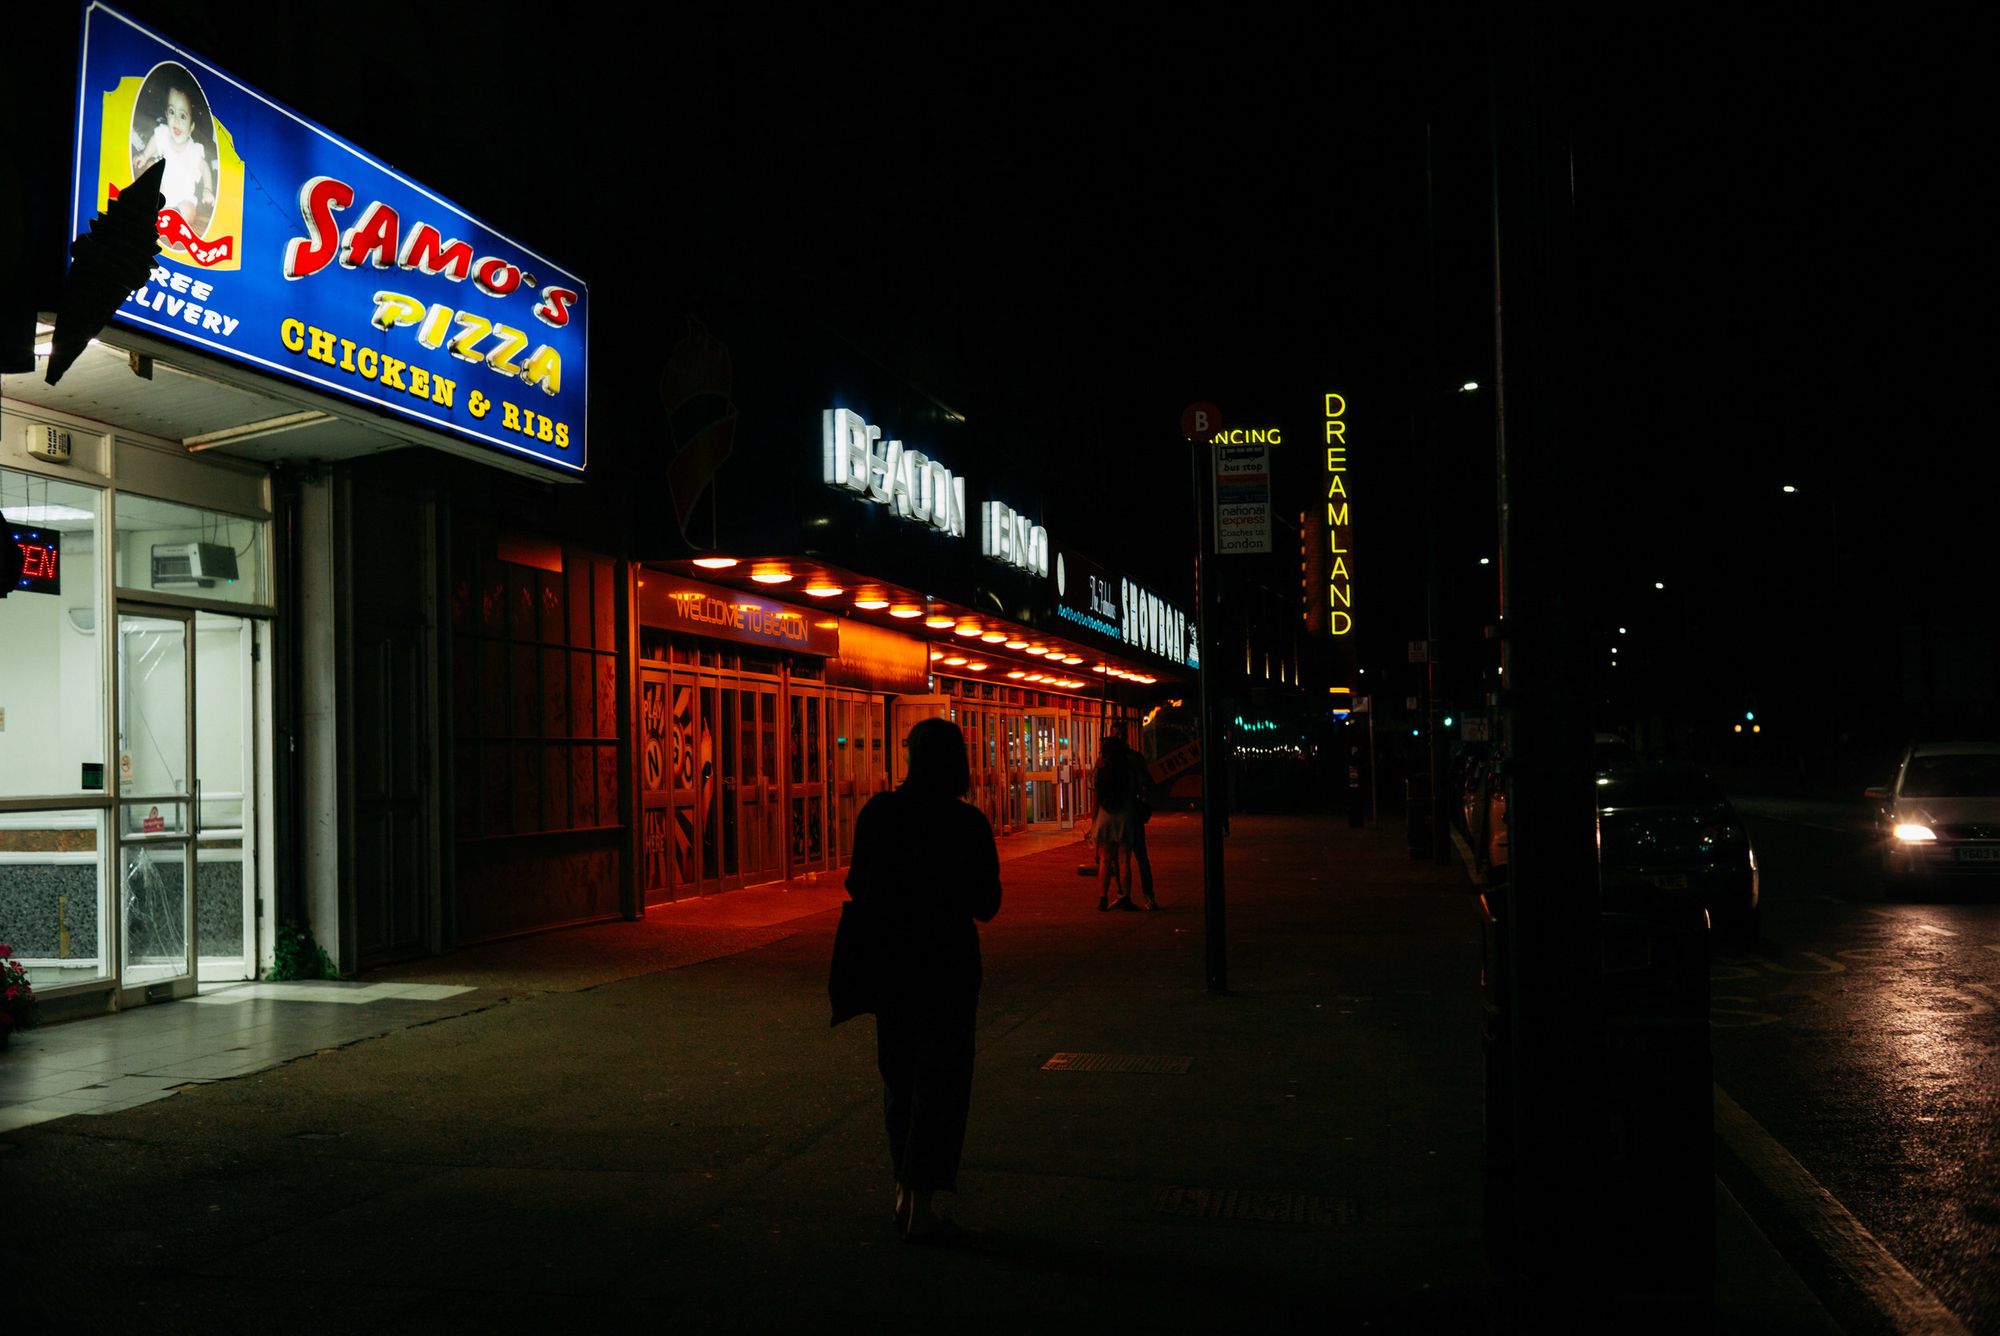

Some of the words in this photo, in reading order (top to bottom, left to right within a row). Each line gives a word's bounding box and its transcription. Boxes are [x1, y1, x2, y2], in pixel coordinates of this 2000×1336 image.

[180, 224, 228, 262] PIZZA
[283, 176, 578, 328] SAMO'S
[150, 266, 213, 301] REE
[126, 286, 240, 336] LIVERY
[371, 290, 561, 397] PIZZA
[280, 318, 456, 408] CHICKEN
[468, 390, 491, 418] &
[502, 401, 569, 449] RIBS
[1195, 410, 1209, 432] B
[1209, 428, 1281, 445] NCING
[823, 408, 966, 538] BEACON
[1224, 463, 1240, 472] bus
[1243, 462, 1263, 473] stop
[1222, 504, 1265, 516] national
[1222, 516, 1265, 528] express
[1325, 393, 1351, 635] DREAMLAND
[17, 543, 57, 579] EN
[1221, 537, 1263, 550] London
[676, 593, 745, 630] WELCOME
[748, 607, 763, 633] TO
[763, 611, 809, 642] BEACON
[1121, 576, 1185, 665] SHOWBOAT
